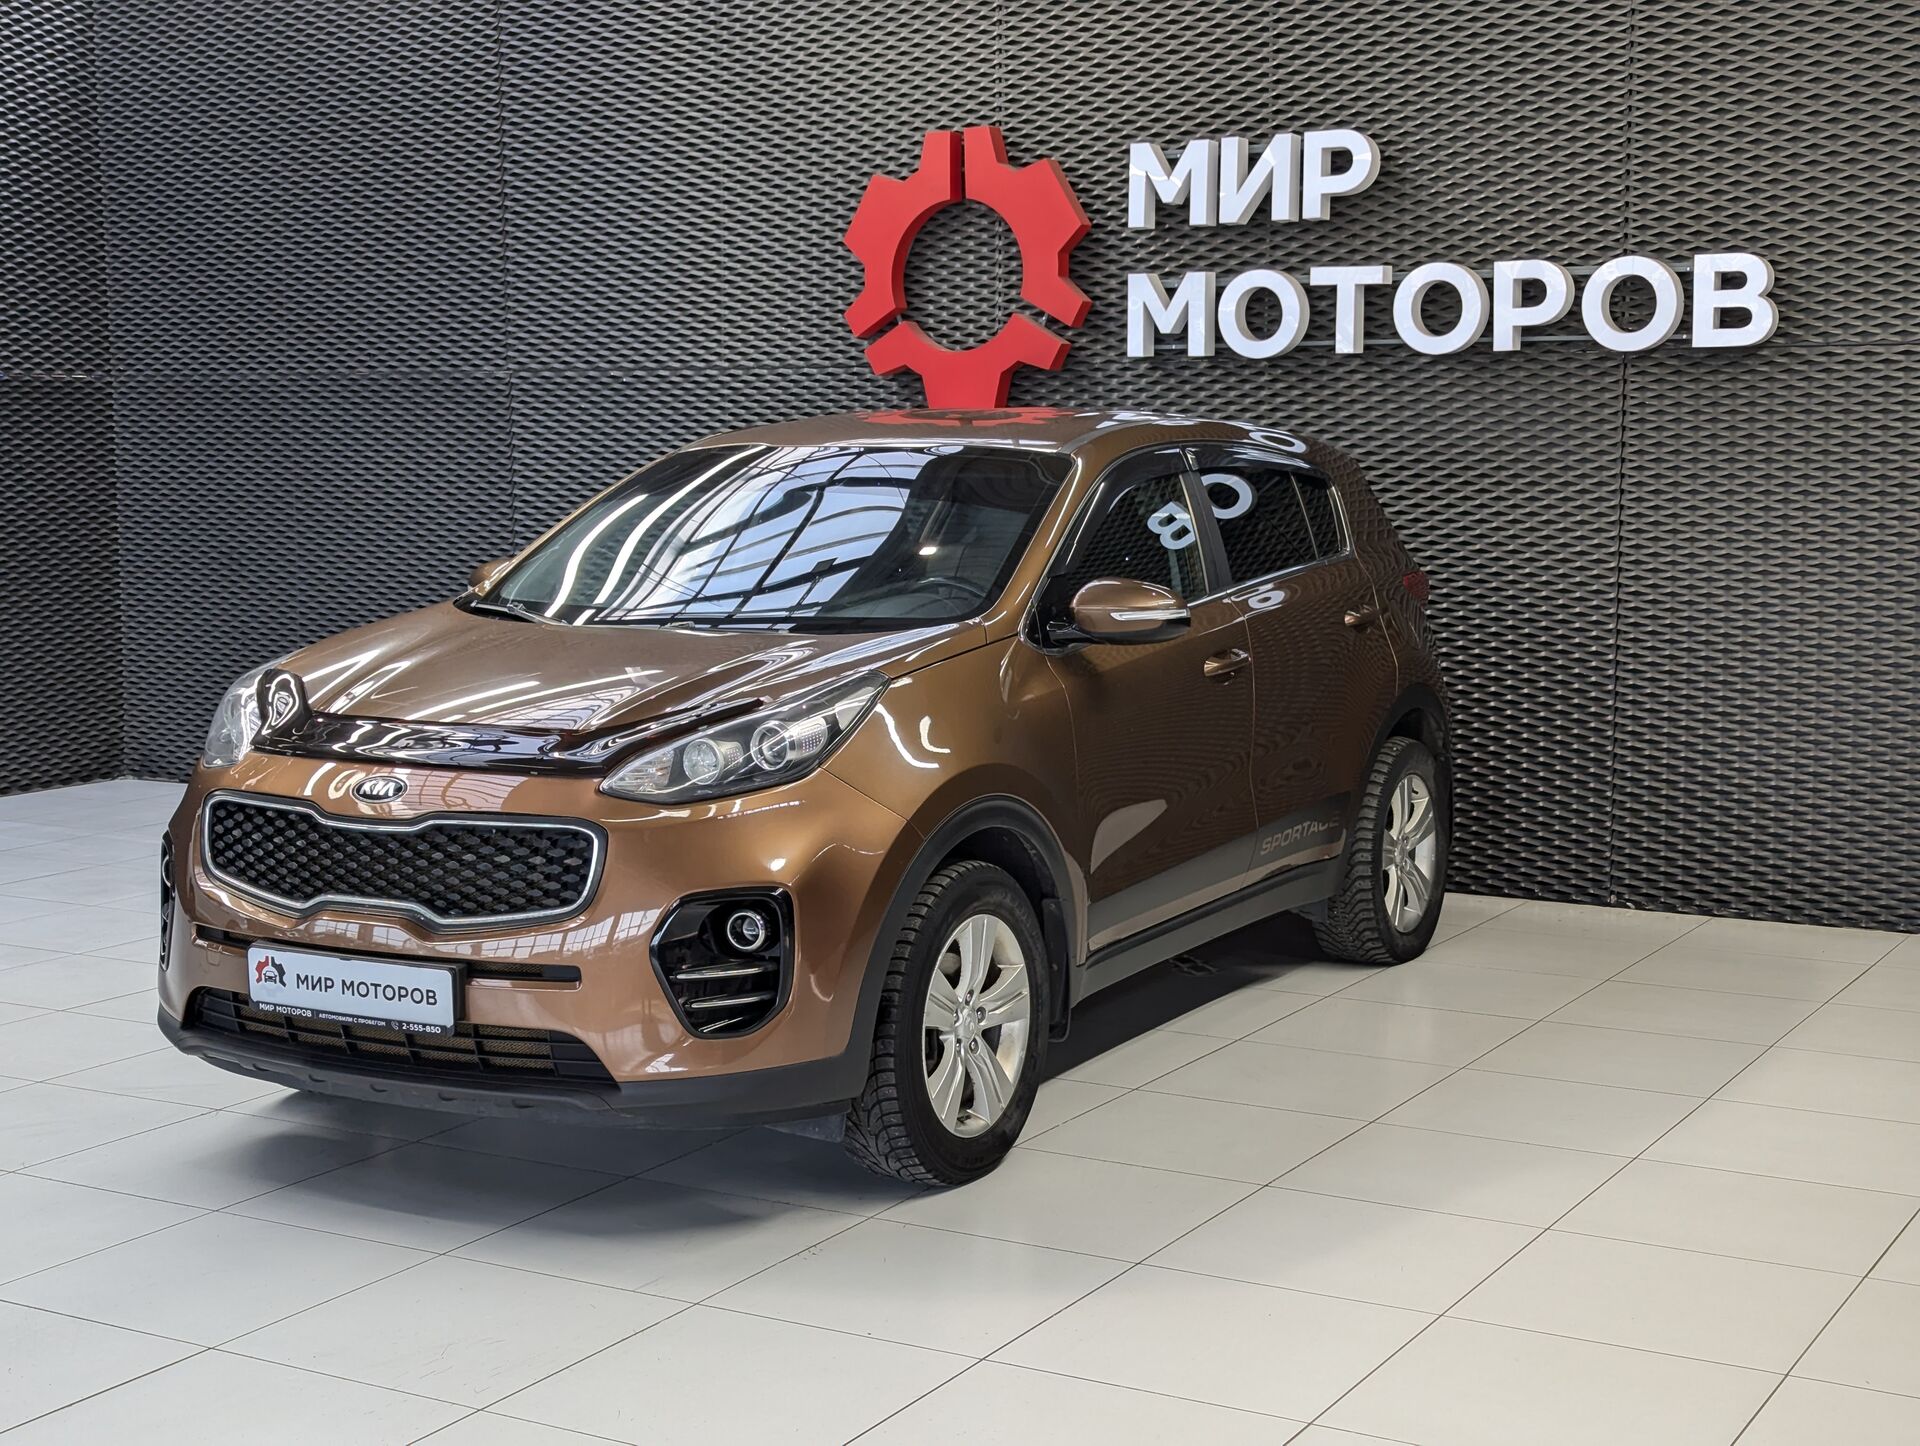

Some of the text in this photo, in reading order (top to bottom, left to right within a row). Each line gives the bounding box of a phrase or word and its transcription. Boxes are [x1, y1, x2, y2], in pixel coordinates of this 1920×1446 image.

[1128, 129, 1380, 229] МИР
[1127, 252, 1779, 359] МОТОРОВ
[359, 780, 396, 797] KIA
[296, 973, 438, 1006] МИР МОТОРОВ
[259, 1003, 312, 1018] МИР МОТОРОВ
[319, 1013, 353, 1024] АВТОМОБИЛИ
[358, 1018, 386, 1027] ПРОБЕГОМ
[402, 1022, 441, 1034] 2-555-850
